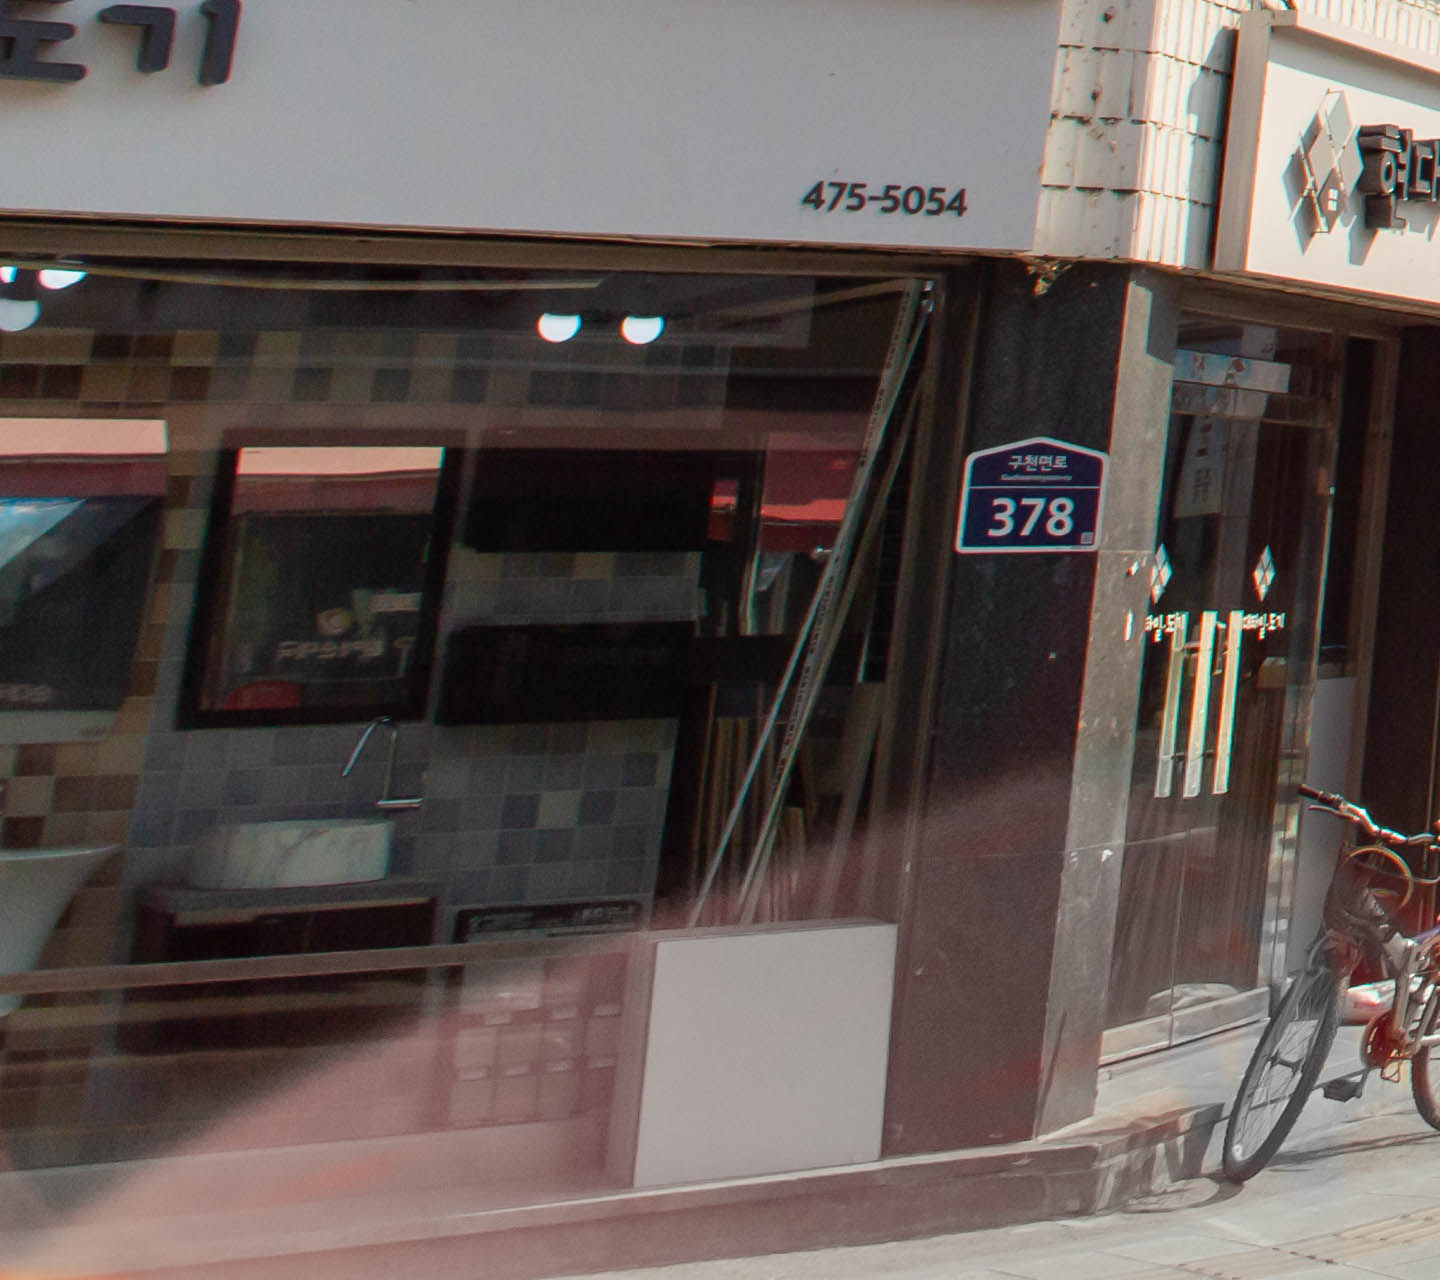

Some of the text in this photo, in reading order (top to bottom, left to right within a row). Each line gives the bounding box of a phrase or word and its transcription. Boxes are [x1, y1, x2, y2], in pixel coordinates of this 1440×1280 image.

[802, 180, 969, 219] 475-5054
[1008, 454, 1069, 473] 구천면로
[987, 497, 1075, 537] 378
